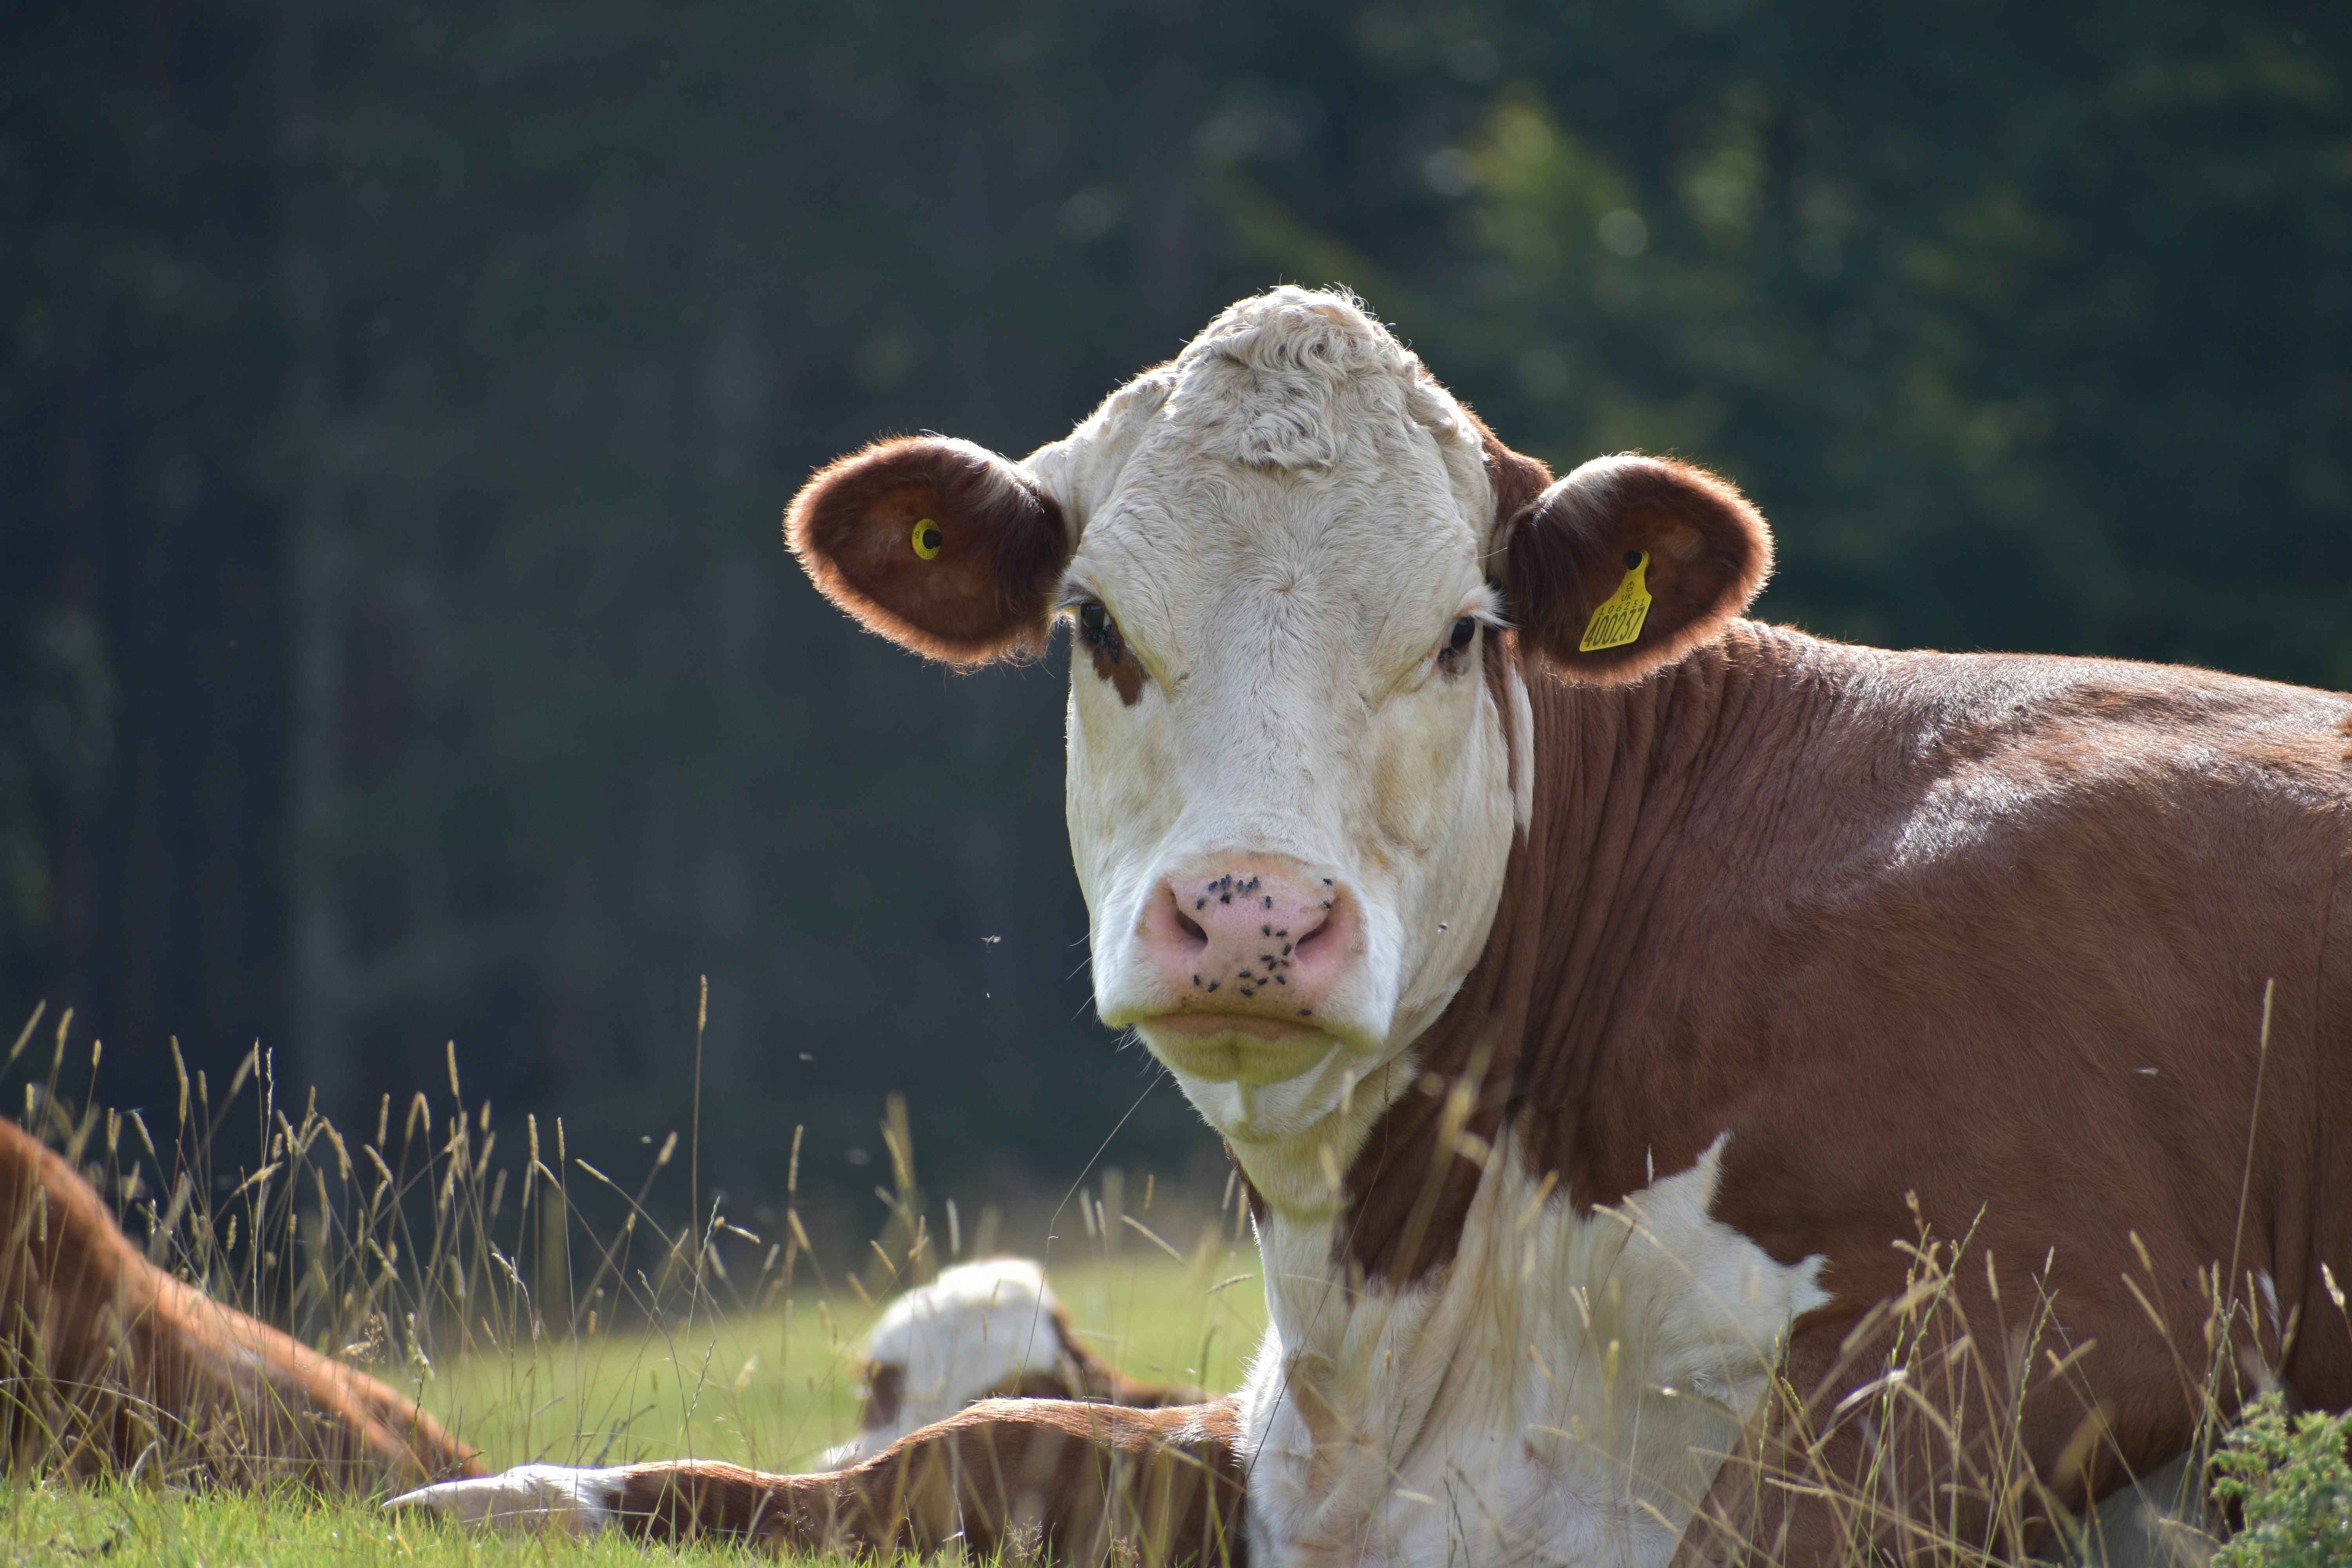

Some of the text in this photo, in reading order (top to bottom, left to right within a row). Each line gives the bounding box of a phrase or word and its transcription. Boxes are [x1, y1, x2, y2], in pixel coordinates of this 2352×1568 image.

[1621, 592, 1633, 601] UK
[1599, 598, 1645, 615] 106251
[1585, 606, 1646, 647] 400237
